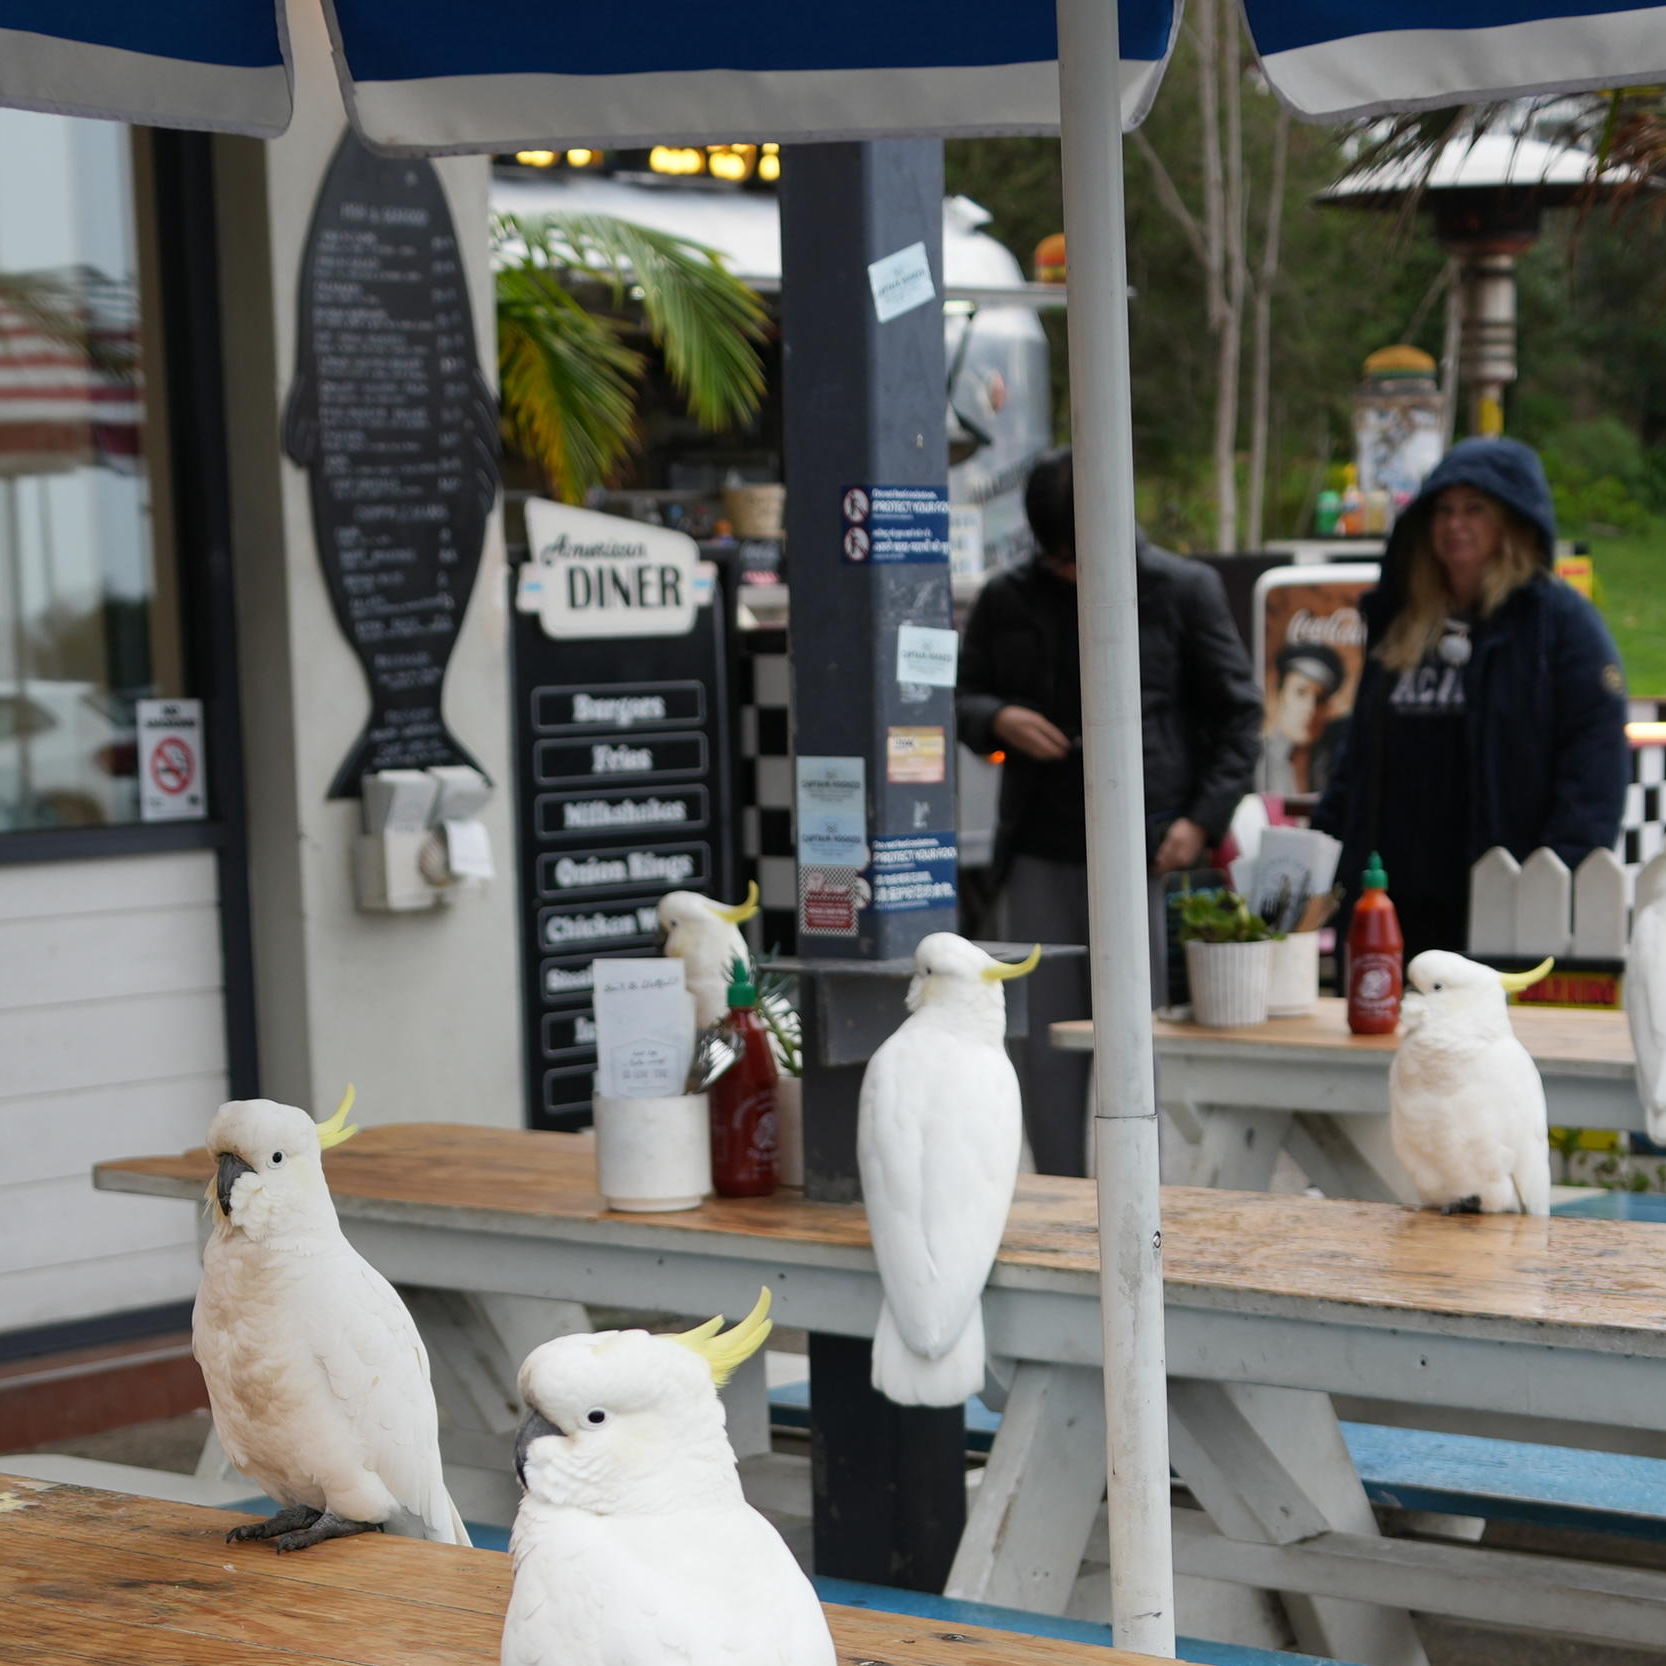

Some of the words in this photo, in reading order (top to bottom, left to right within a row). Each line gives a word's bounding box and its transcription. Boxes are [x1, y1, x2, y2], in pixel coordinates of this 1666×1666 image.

[541, 534, 647, 566] American
[567, 565, 682, 608] DINER
[572, 694, 665, 727] Burgers
[591, 745, 653, 773] Fries
[564, 798, 687, 828] Milkshakes
[555, 857, 627, 888] Onion
[628, 851, 694, 885] Rings
[546, 912, 637, 944] Chicken
